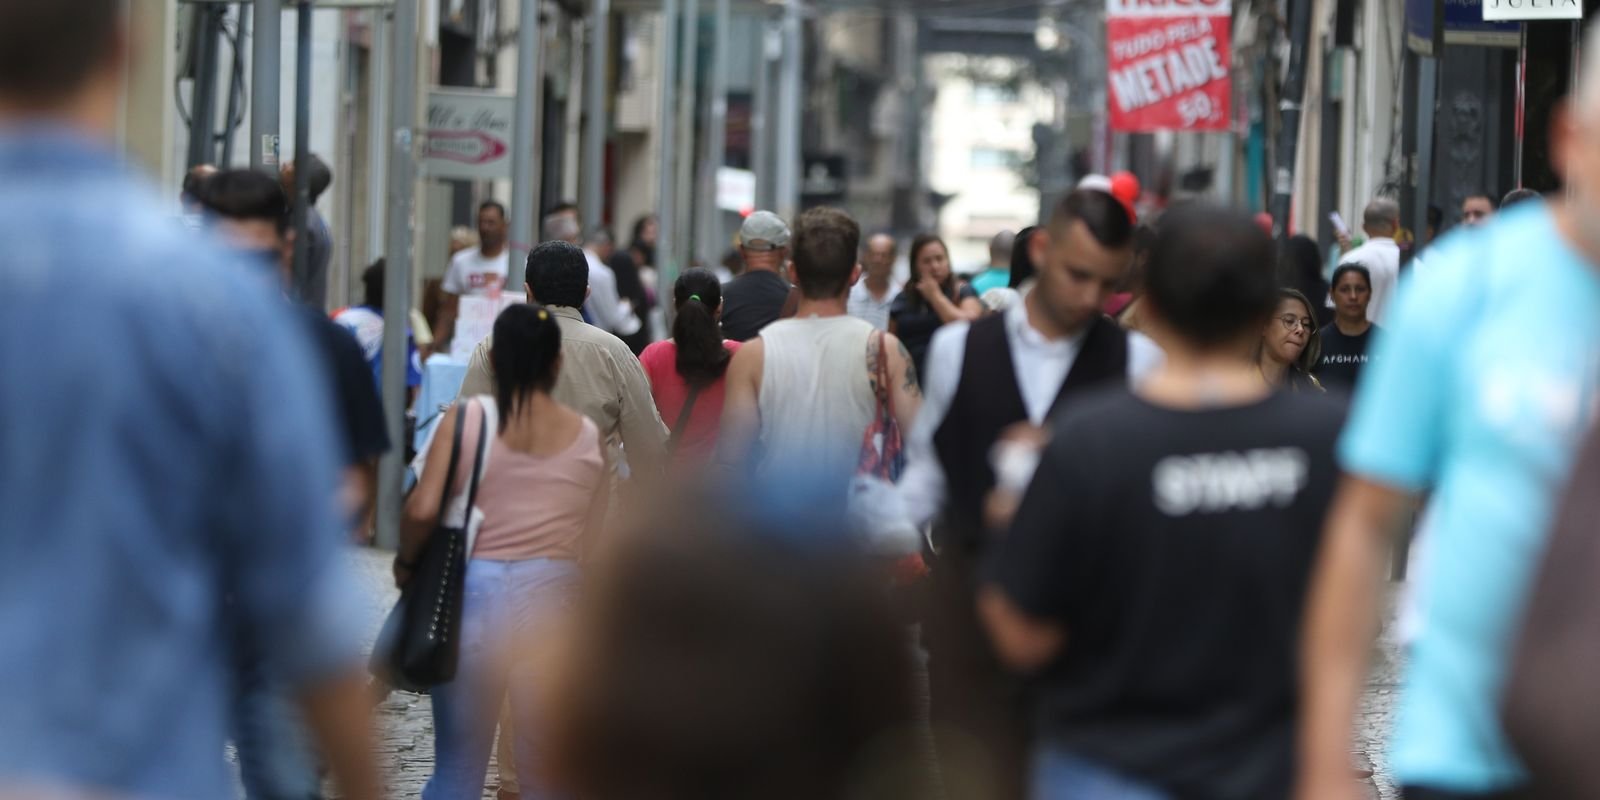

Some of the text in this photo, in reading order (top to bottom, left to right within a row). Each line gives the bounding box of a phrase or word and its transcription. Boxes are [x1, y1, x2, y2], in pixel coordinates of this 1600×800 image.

[1112, 16, 1212, 60] TUDO PELA
[1109, 36, 1227, 112] METADE
[1323, 354, 1368, 365] AFGHAN
[1152, 447, 1310, 518] STAFF
